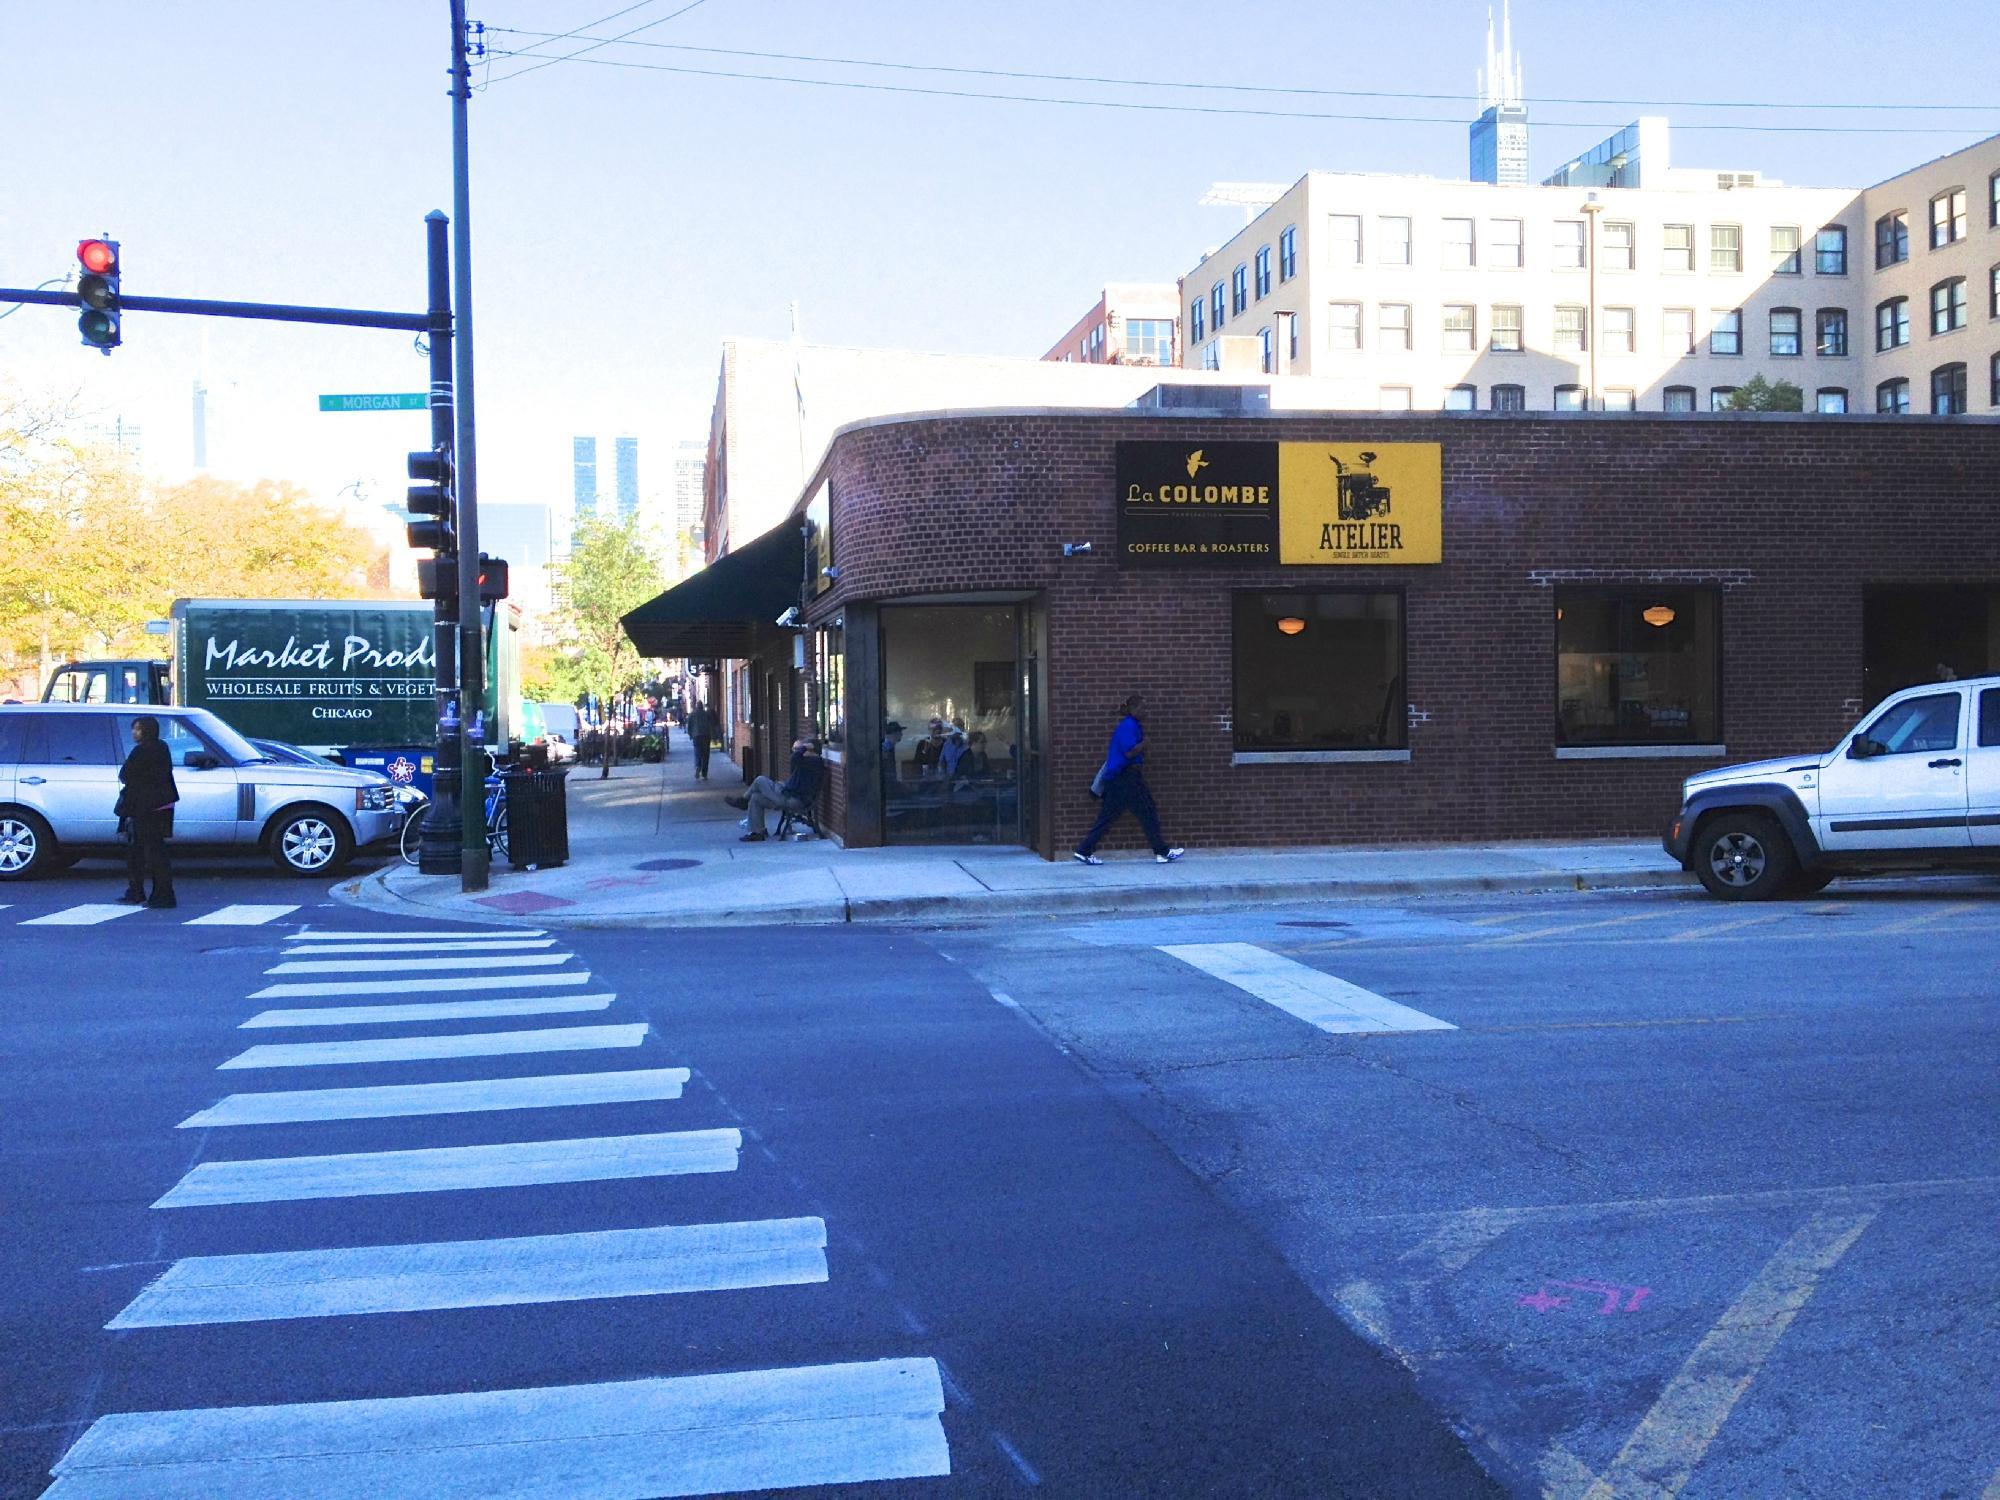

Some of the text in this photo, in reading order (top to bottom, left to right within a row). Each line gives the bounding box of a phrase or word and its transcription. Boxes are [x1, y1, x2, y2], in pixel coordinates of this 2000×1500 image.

[342, 396, 401, 409] MORGAN
[1126, 484, 1270, 504] La COLOMBE
[1319, 523, 1404, 550] ATELIER
[1128, 543, 1270, 553] COFFEE BAR & ROASTERS
[205, 635, 334, 671] Market
[206, 683, 302, 695] WHOLESALE
[309, 683, 363, 695] FRUITS
[368, 683, 381, 695] &
[312, 706, 373, 719] CHICAGO
